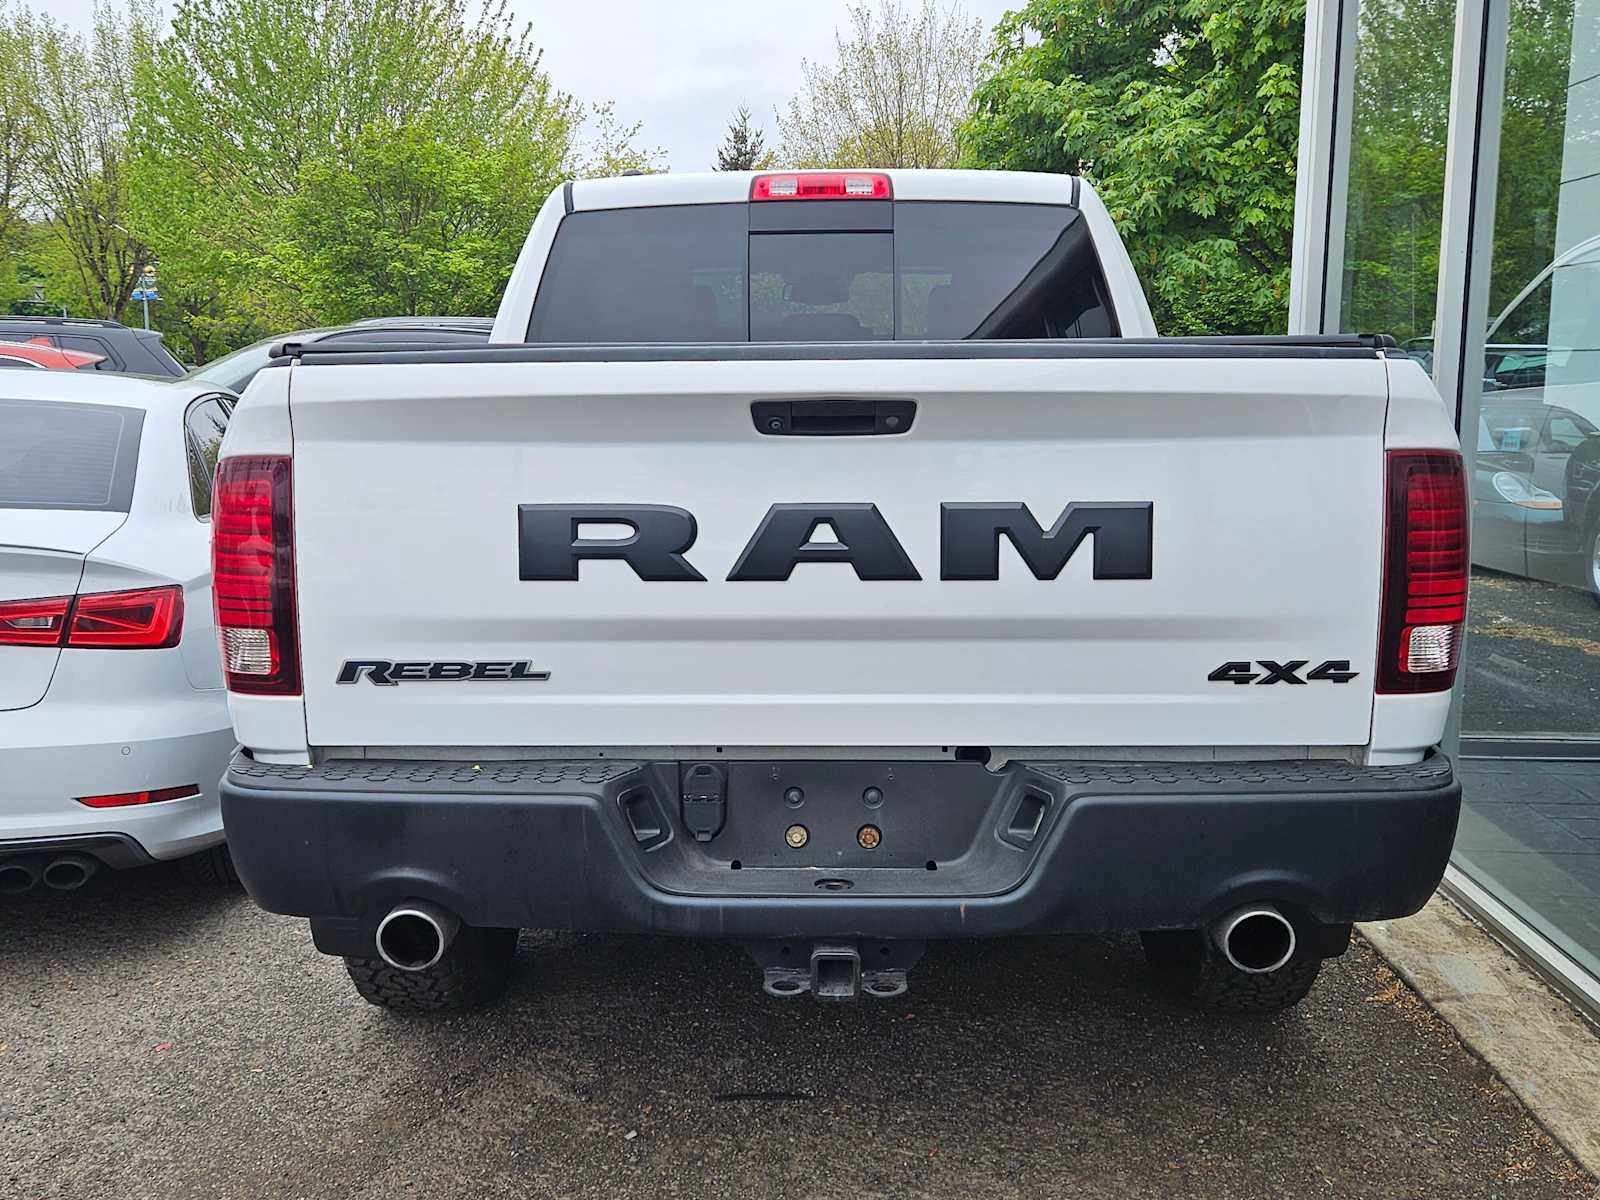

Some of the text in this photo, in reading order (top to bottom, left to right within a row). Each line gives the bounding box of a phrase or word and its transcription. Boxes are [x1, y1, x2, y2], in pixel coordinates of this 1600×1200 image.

[518, 501, 1154, 582] RAM
[336, 659, 551, 686] REBEL
[1207, 660, 1360, 685] 4X4
